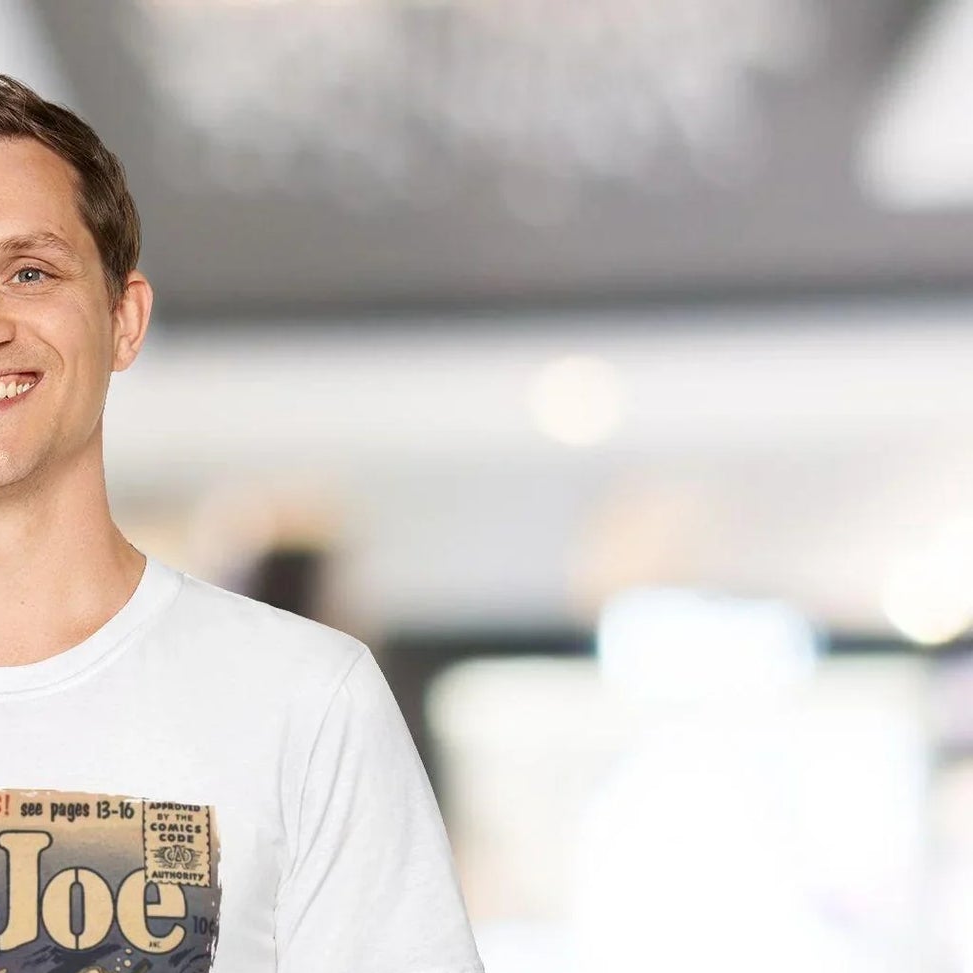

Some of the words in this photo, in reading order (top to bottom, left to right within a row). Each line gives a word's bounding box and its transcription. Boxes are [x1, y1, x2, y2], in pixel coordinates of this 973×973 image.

[20, 803, 43, 817] see
[50, 803, 90, 822] pages
[96, 801, 135, 819] 13-16
[149, 802, 201, 812] APPROVED
[157, 813, 169, 821] BY
[176, 814, 194, 822] THE
[150, 823, 202, 834] COMICS
[159, 834, 195, 844] CODE
[152, 871, 205, 881] AUTHORITY
